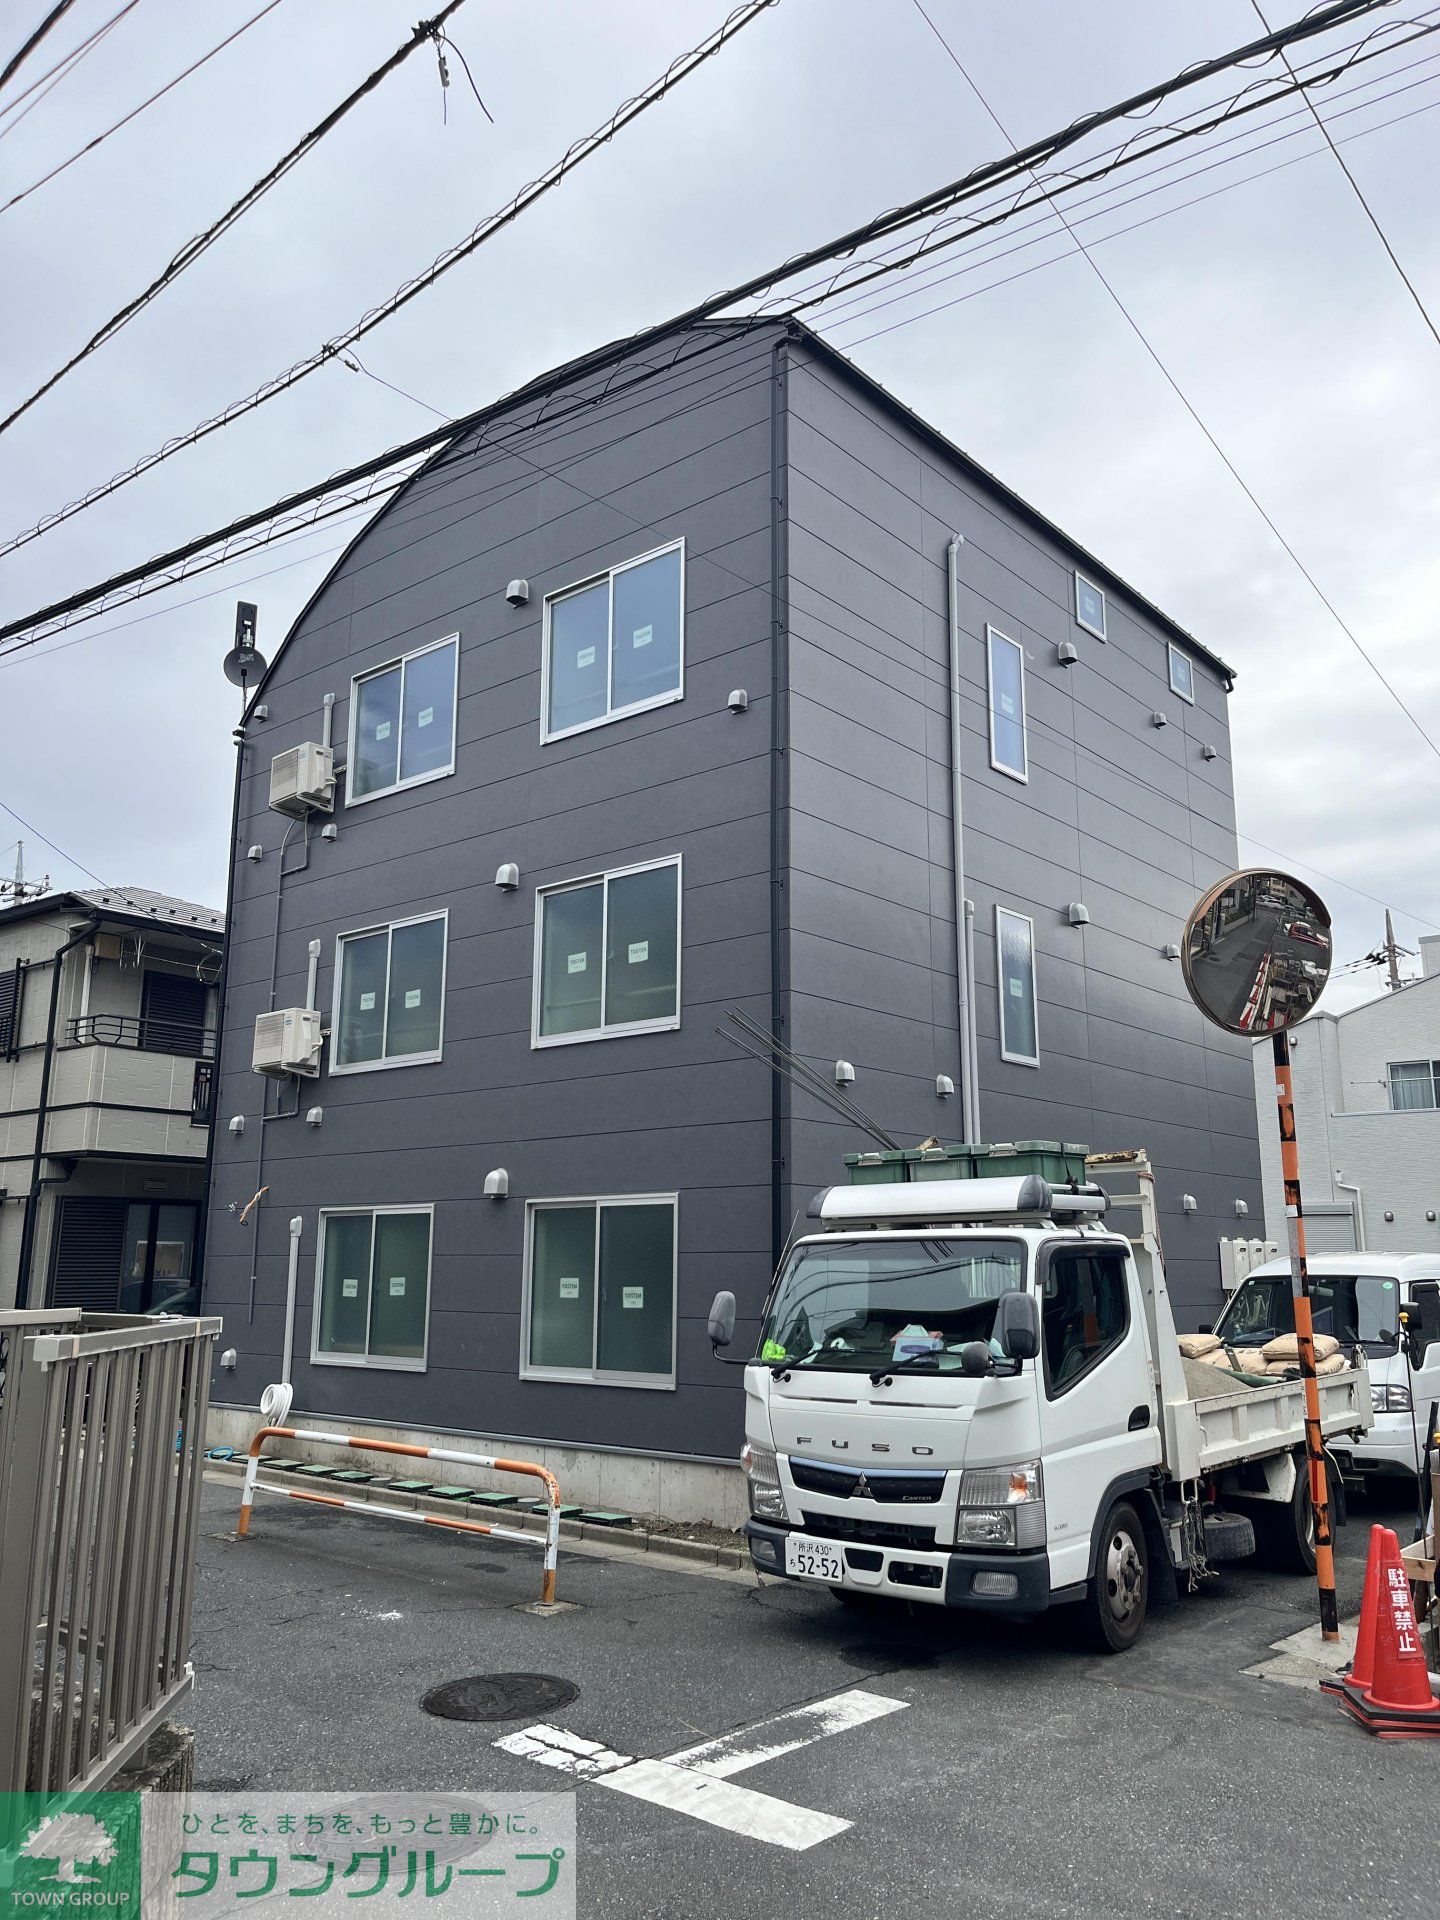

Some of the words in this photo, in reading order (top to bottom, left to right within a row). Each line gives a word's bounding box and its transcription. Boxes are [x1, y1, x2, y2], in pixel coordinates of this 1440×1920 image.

[797, 1436, 933, 1455] FUSO
[815, 1545, 829, 1555] 430
[798, 1555, 839, 1578] 52-52
[1388, 1568, 1417, 1652] 駐車禁止
